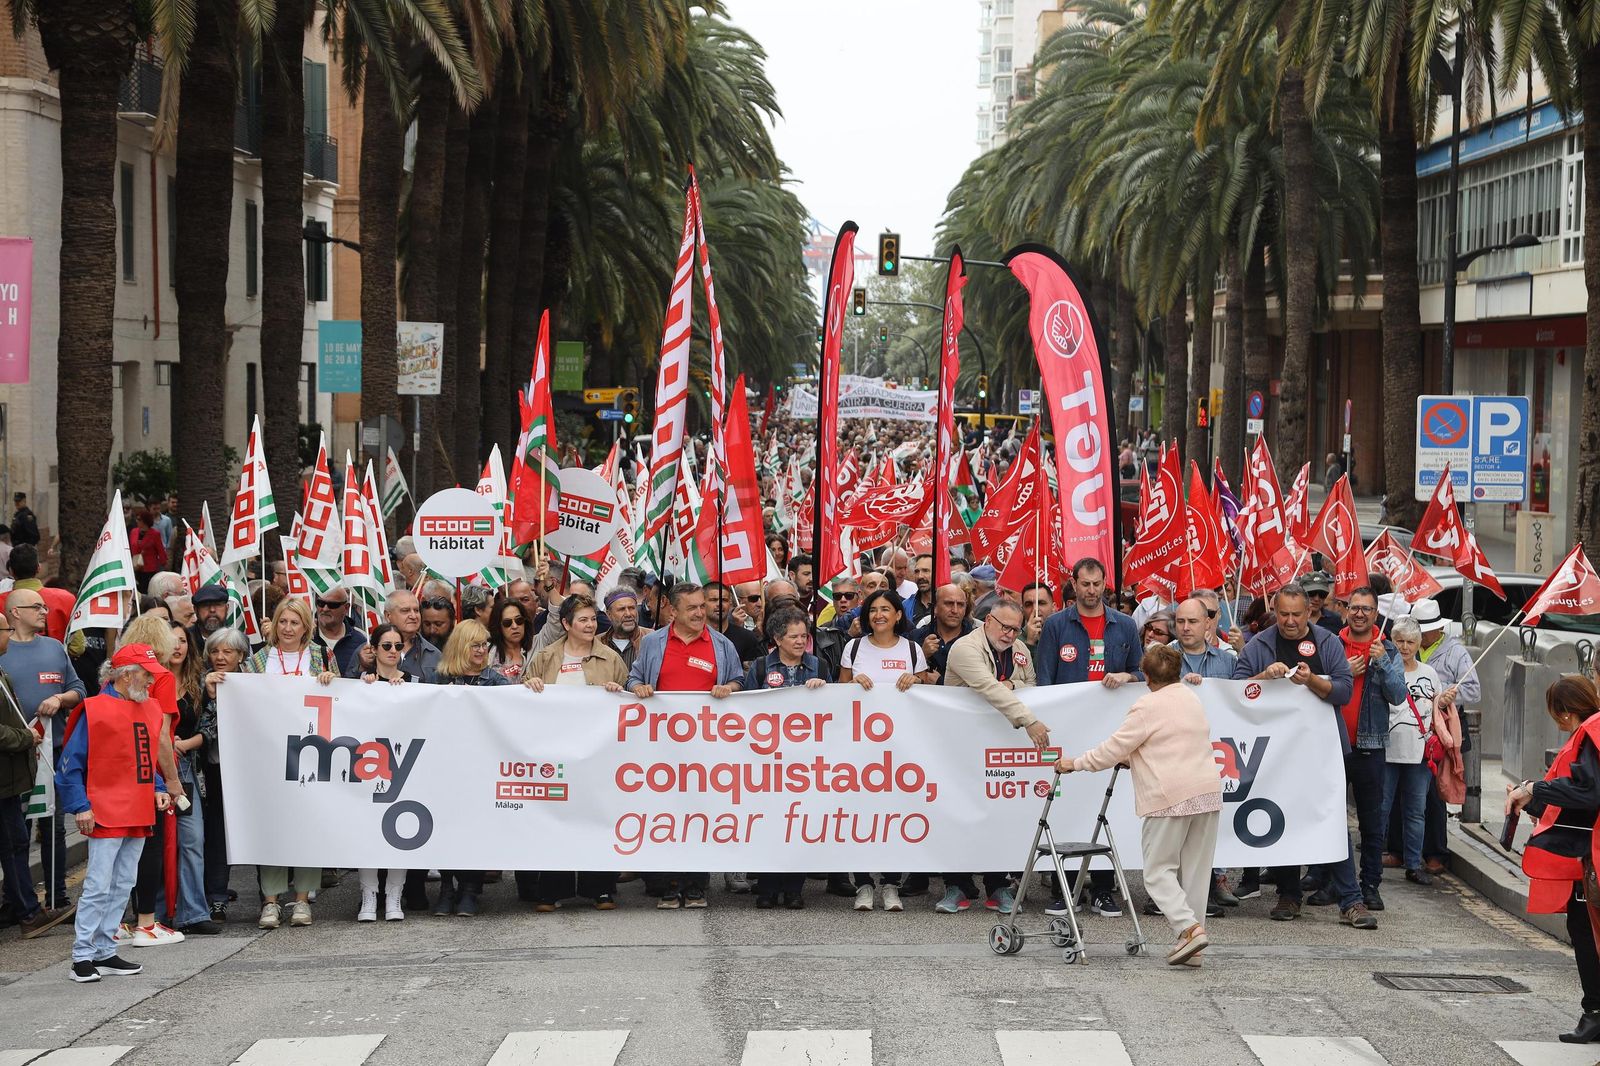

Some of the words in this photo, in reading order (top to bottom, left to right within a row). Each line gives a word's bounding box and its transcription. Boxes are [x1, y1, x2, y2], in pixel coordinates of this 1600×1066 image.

[1479, 402, 1521, 455] P
[559, 497, 591, 513] COO
[424, 520, 471, 532] CCOO
[558, 514, 601, 535] ábitat
[429, 537, 485, 550] hábitat
[617, 527, 636, 564] Málag
[1130, 535, 1183, 571] www.ugt.es
[616, 702, 833, 755] Proteger
[852, 701, 894, 743] lo
[988, 751, 1037, 764] CCOO
[500, 762, 538, 779] UGT
[614, 750, 938, 805] conquistado,
[985, 768, 1016, 779] Málaga
[499, 785, 545, 797] CCOO
[985, 781, 1030, 799] UGT
[1211, 736, 1285, 848] ayo
[495, 801, 524, 811] Málaga
[613, 811, 763, 856] ganar
[784, 801, 930, 844] futuro
